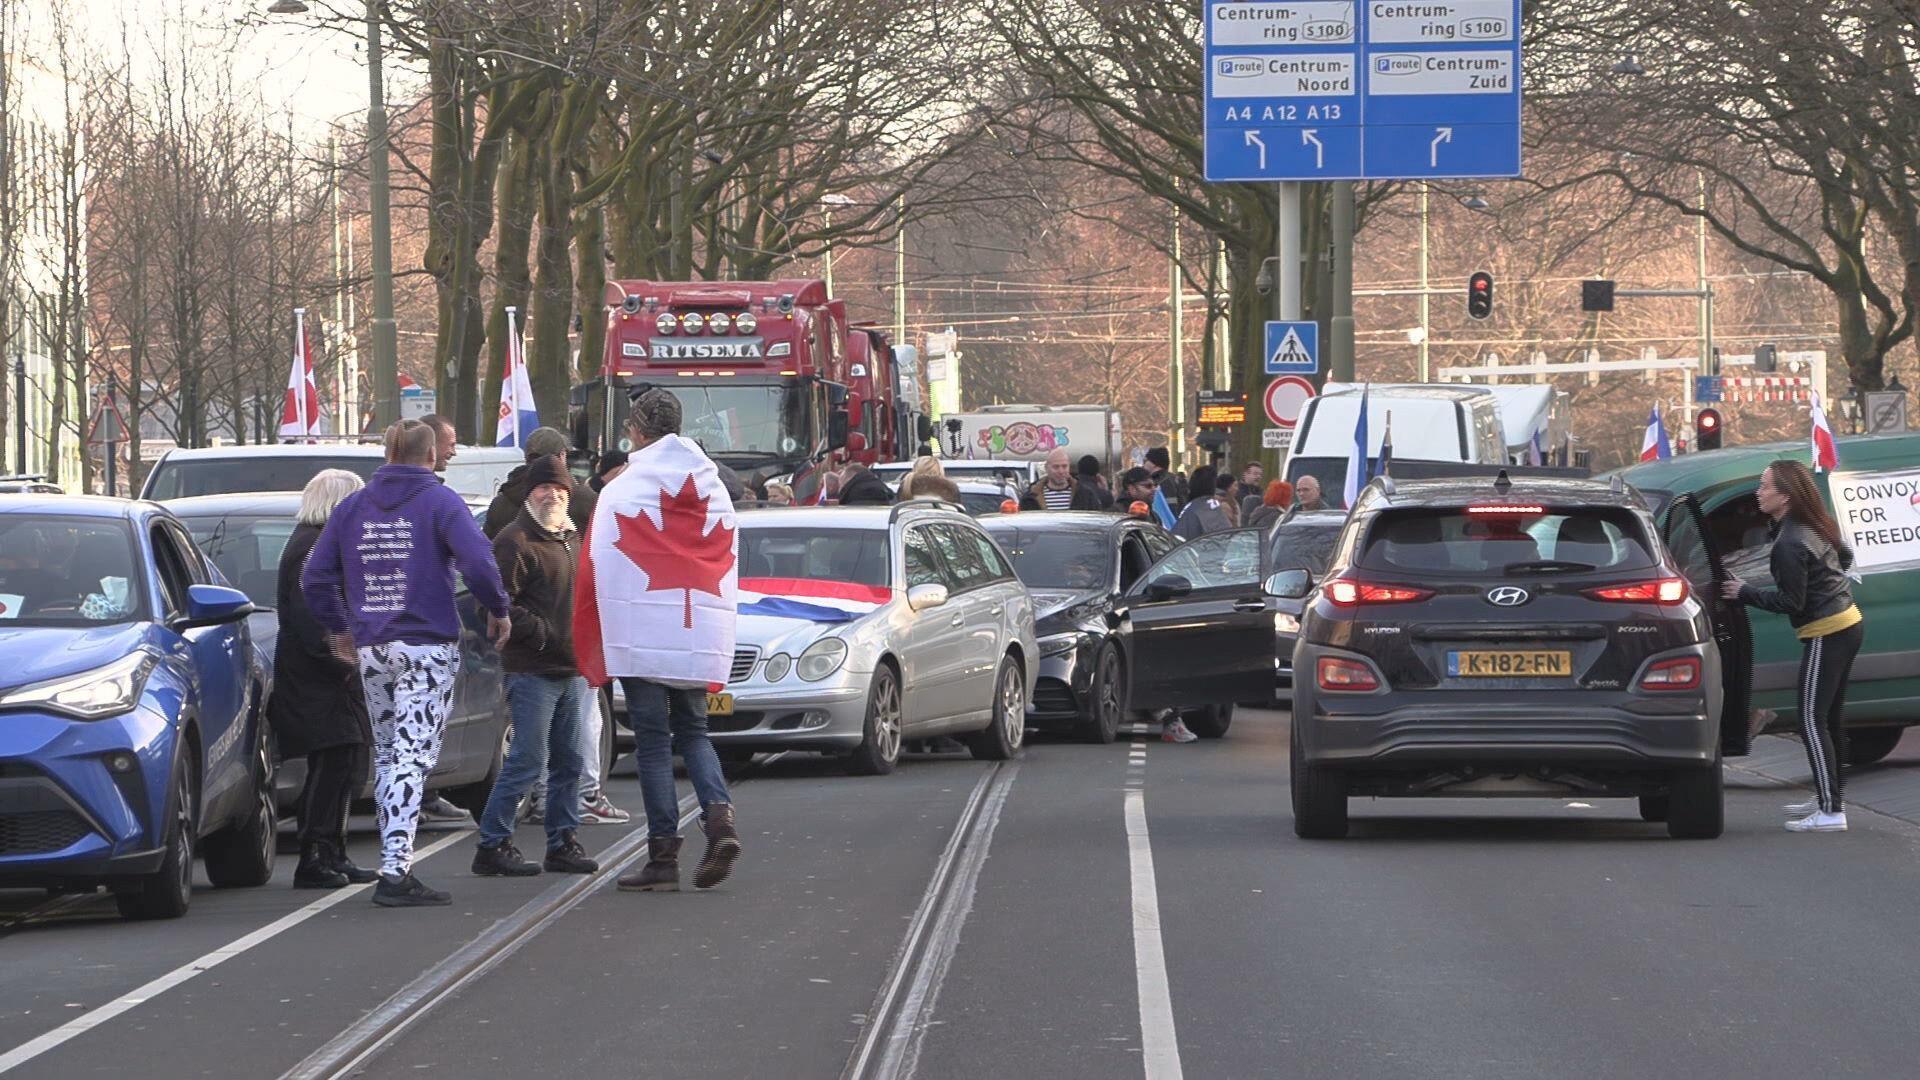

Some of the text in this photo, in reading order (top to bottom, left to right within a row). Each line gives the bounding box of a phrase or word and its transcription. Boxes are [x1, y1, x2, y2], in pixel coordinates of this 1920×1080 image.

[1217, 6, 1297, 20] Centrum-
[1374, 4, 1455, 18] Centrum-
[1264, 24, 1297, 41] ring
[1421, 21, 1455, 38] ring
[1234, 62, 1262, 71] route
[1269, 60, 1349, 73] Centrum-
[1391, 59, 1420, 69] route
[1425, 56, 1507, 70] Centrum-
[1298, 77, 1349, 92] Noord
[1469, 75, 1508, 89] Zuid
[652, 344, 761, 358] RITSEMA
[1843, 480, 1918, 502] CONVOY
[1849, 507, 1887, 524] FOR
[1469, 654, 1560, 672] K-182-FN
